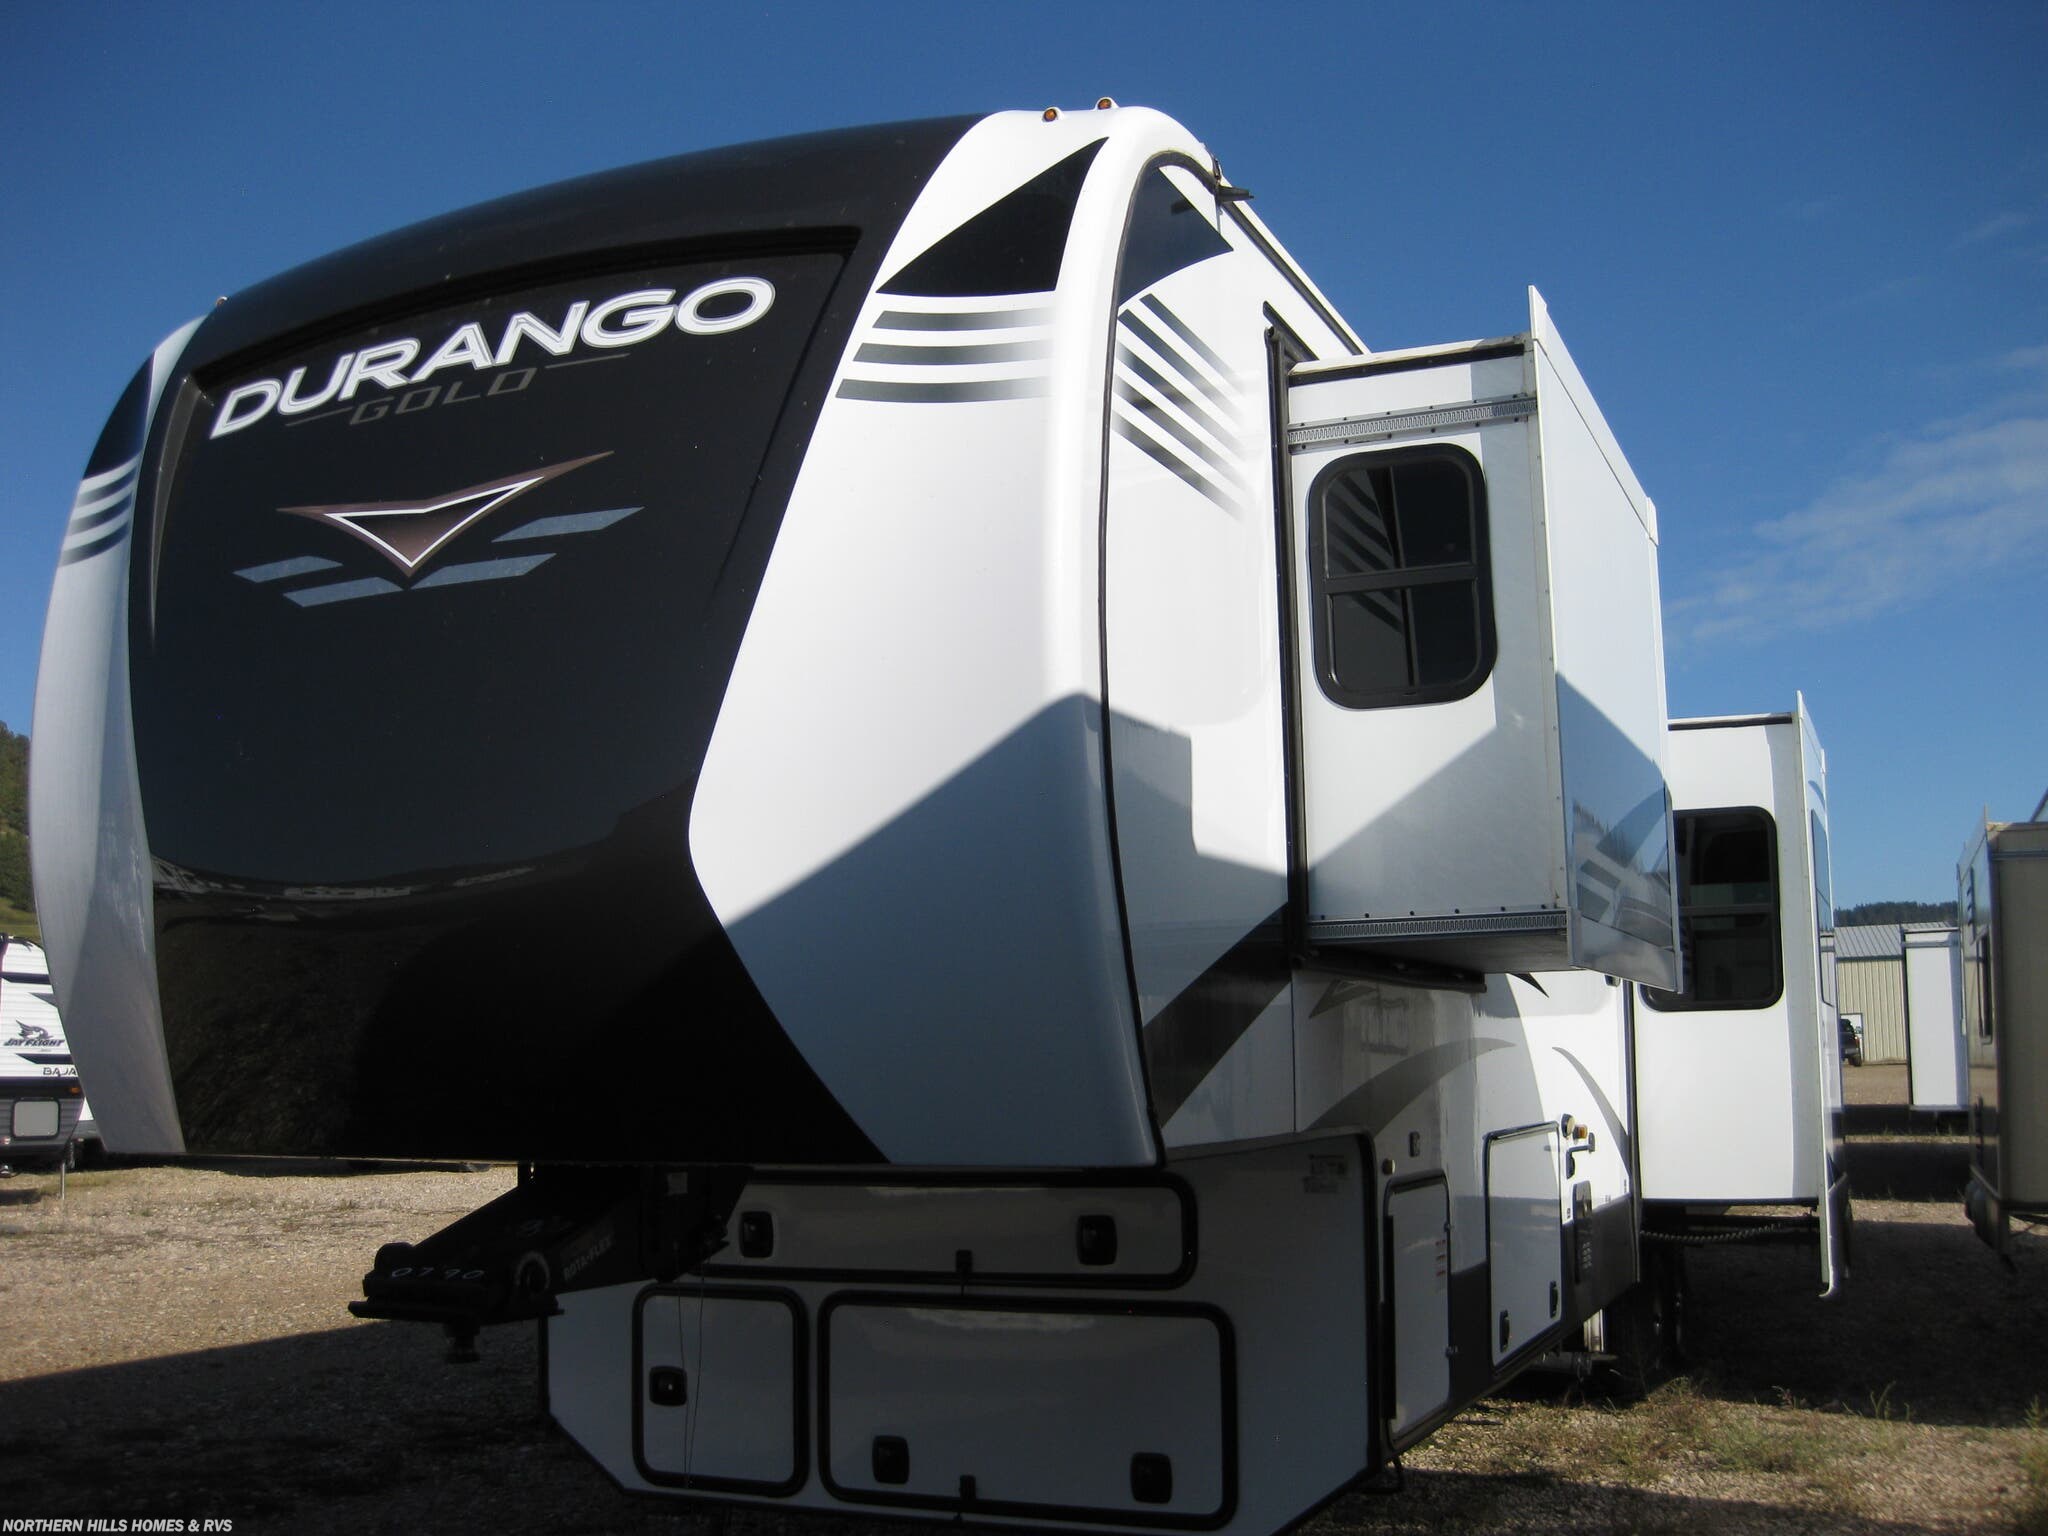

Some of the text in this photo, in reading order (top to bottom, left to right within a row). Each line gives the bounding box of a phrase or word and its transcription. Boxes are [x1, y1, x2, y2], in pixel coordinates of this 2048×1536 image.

[209, 276, 775, 439] DURANGO
[349, 367, 536, 427] GOLD
[43, 1067, 77, 1076] BAJA
